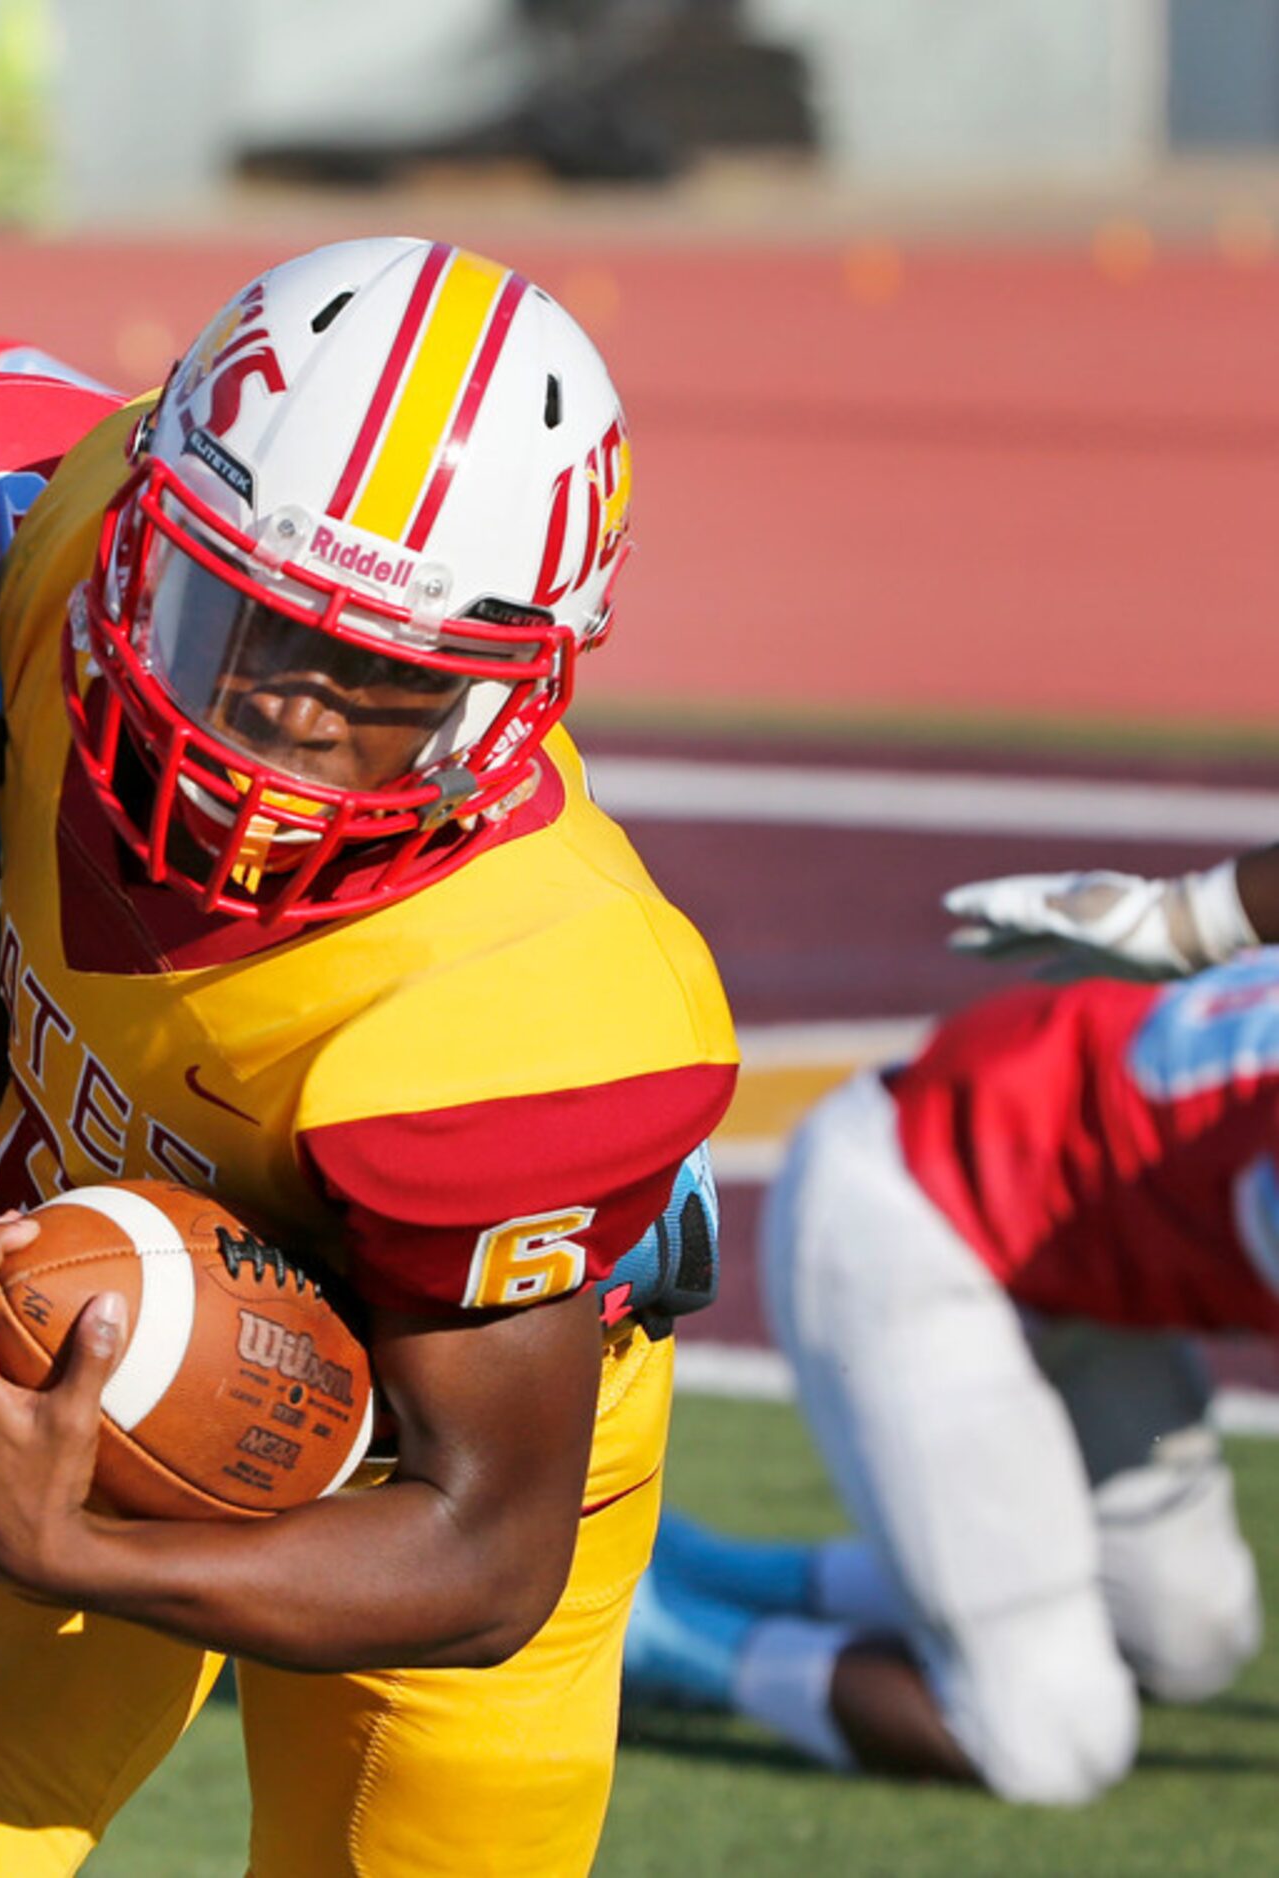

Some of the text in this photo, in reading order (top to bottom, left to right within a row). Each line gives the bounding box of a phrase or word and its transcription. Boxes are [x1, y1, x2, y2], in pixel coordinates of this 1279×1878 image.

[309, 525, 415, 588] Riddell
[461, 1205, 597, 1309] 6
[237, 1308, 355, 1407] Wilson
